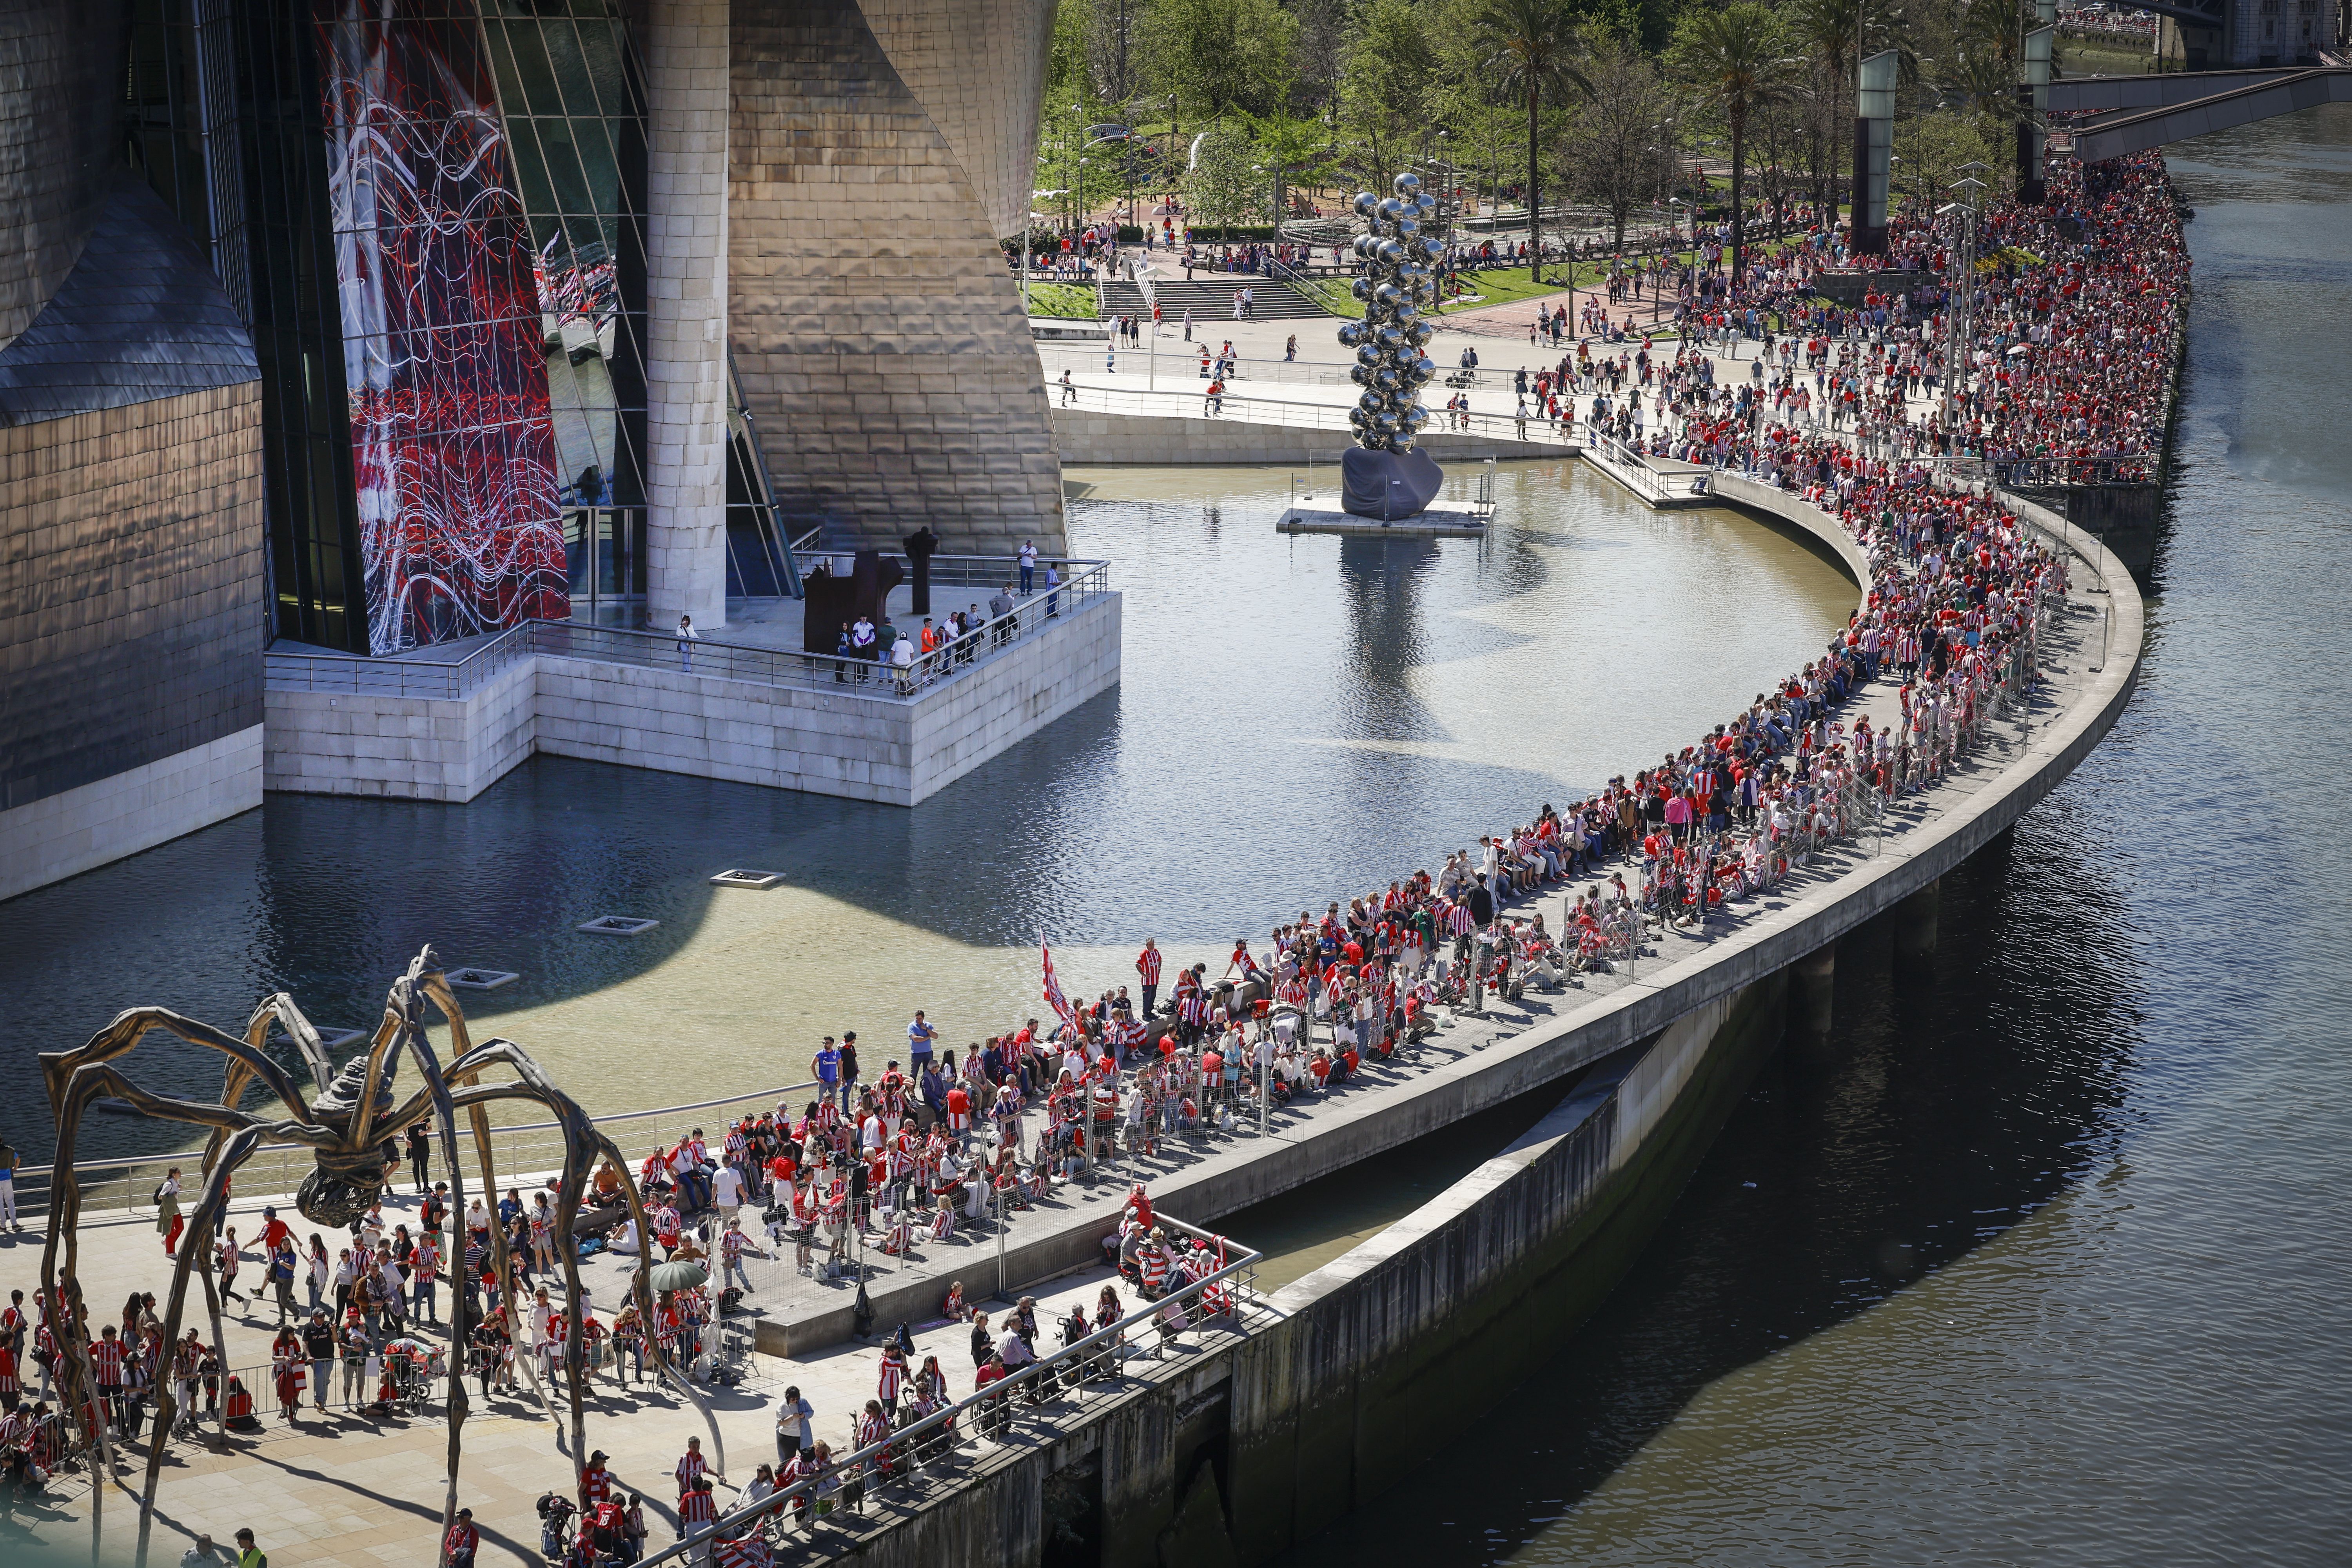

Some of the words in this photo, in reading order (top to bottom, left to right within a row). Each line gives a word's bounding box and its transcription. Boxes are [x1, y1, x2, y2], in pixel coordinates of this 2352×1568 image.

[1406, 937, 1416, 948] 21
[660, 1216, 670, 1229] 14
[599, 1515, 610, 1526] 18
